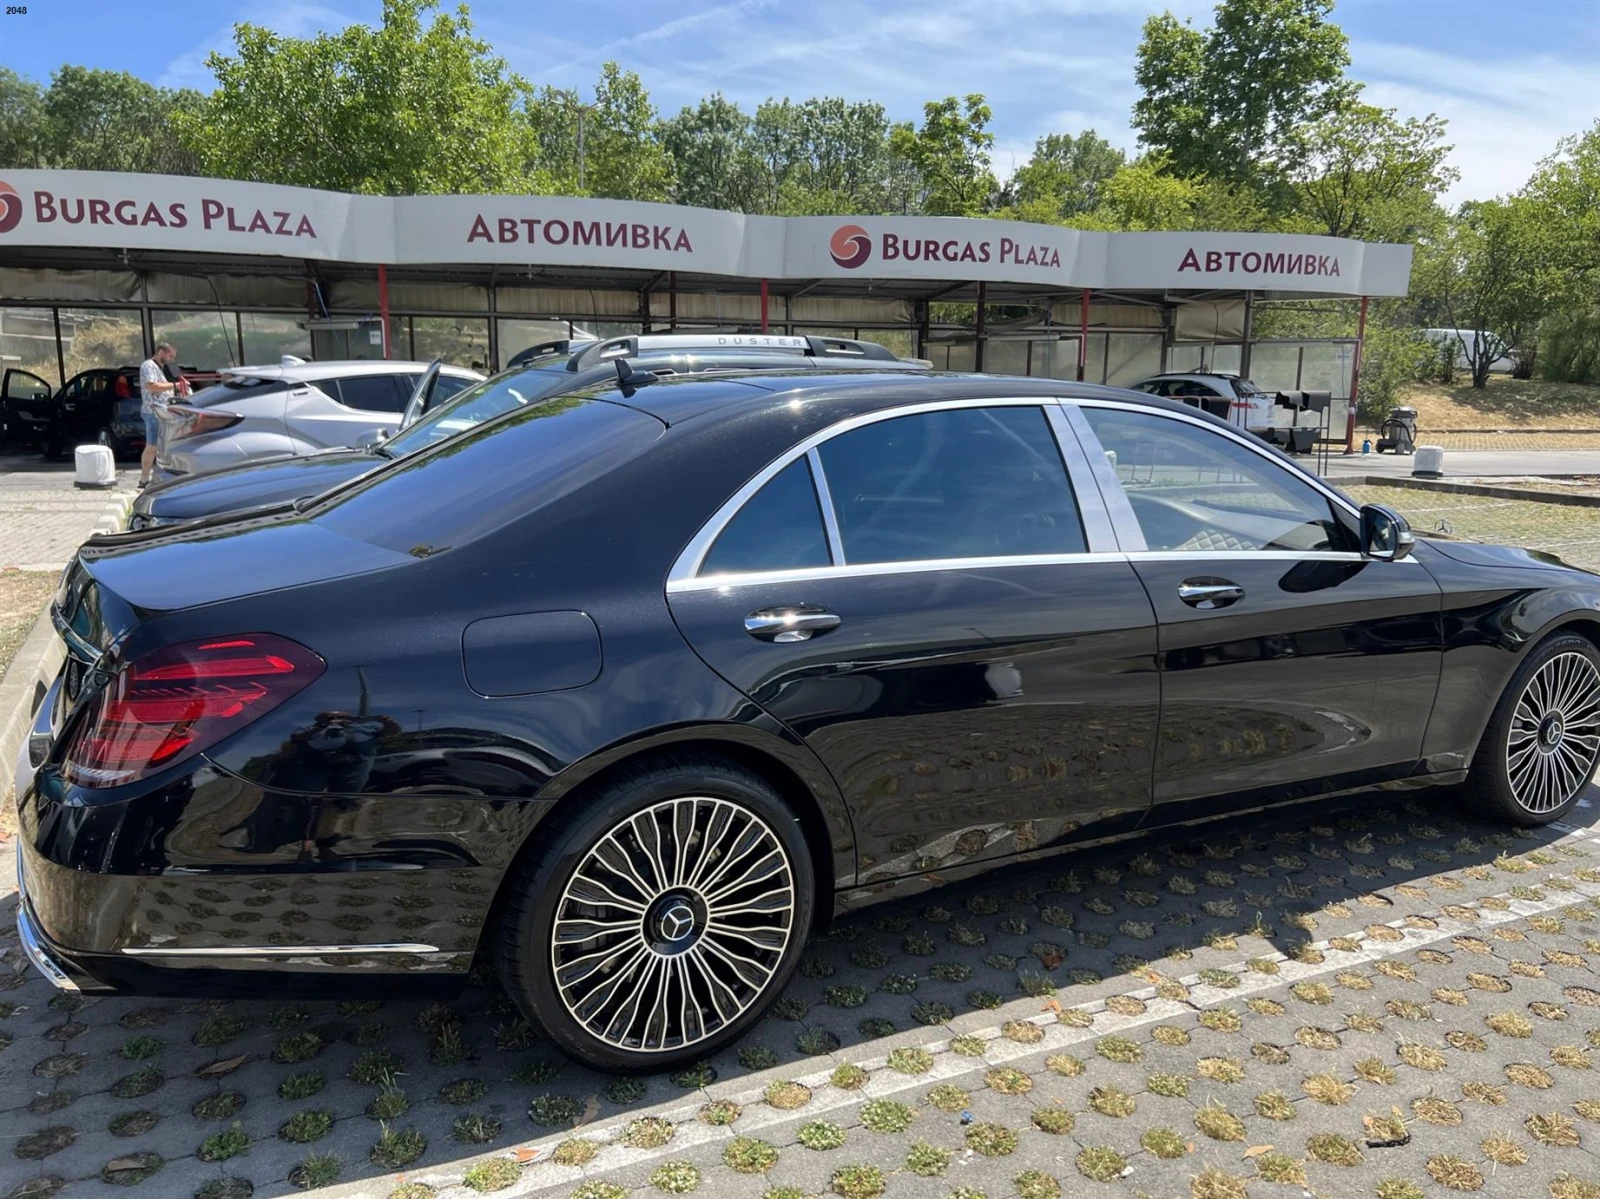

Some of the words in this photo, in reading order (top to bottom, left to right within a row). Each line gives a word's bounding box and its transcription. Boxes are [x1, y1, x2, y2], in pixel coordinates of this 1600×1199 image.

[34, 190, 188, 229] BURGAS
[201, 198, 318, 239] PLAZA
[466, 213, 693, 253] АВТОМИВКА
[882, 233, 991, 263] BURGAS
[999, 237, 1061, 268] PLAZA
[1177, 247, 1340, 277] АВТОМИВКА
[717, 337, 803, 347] DUSTER
